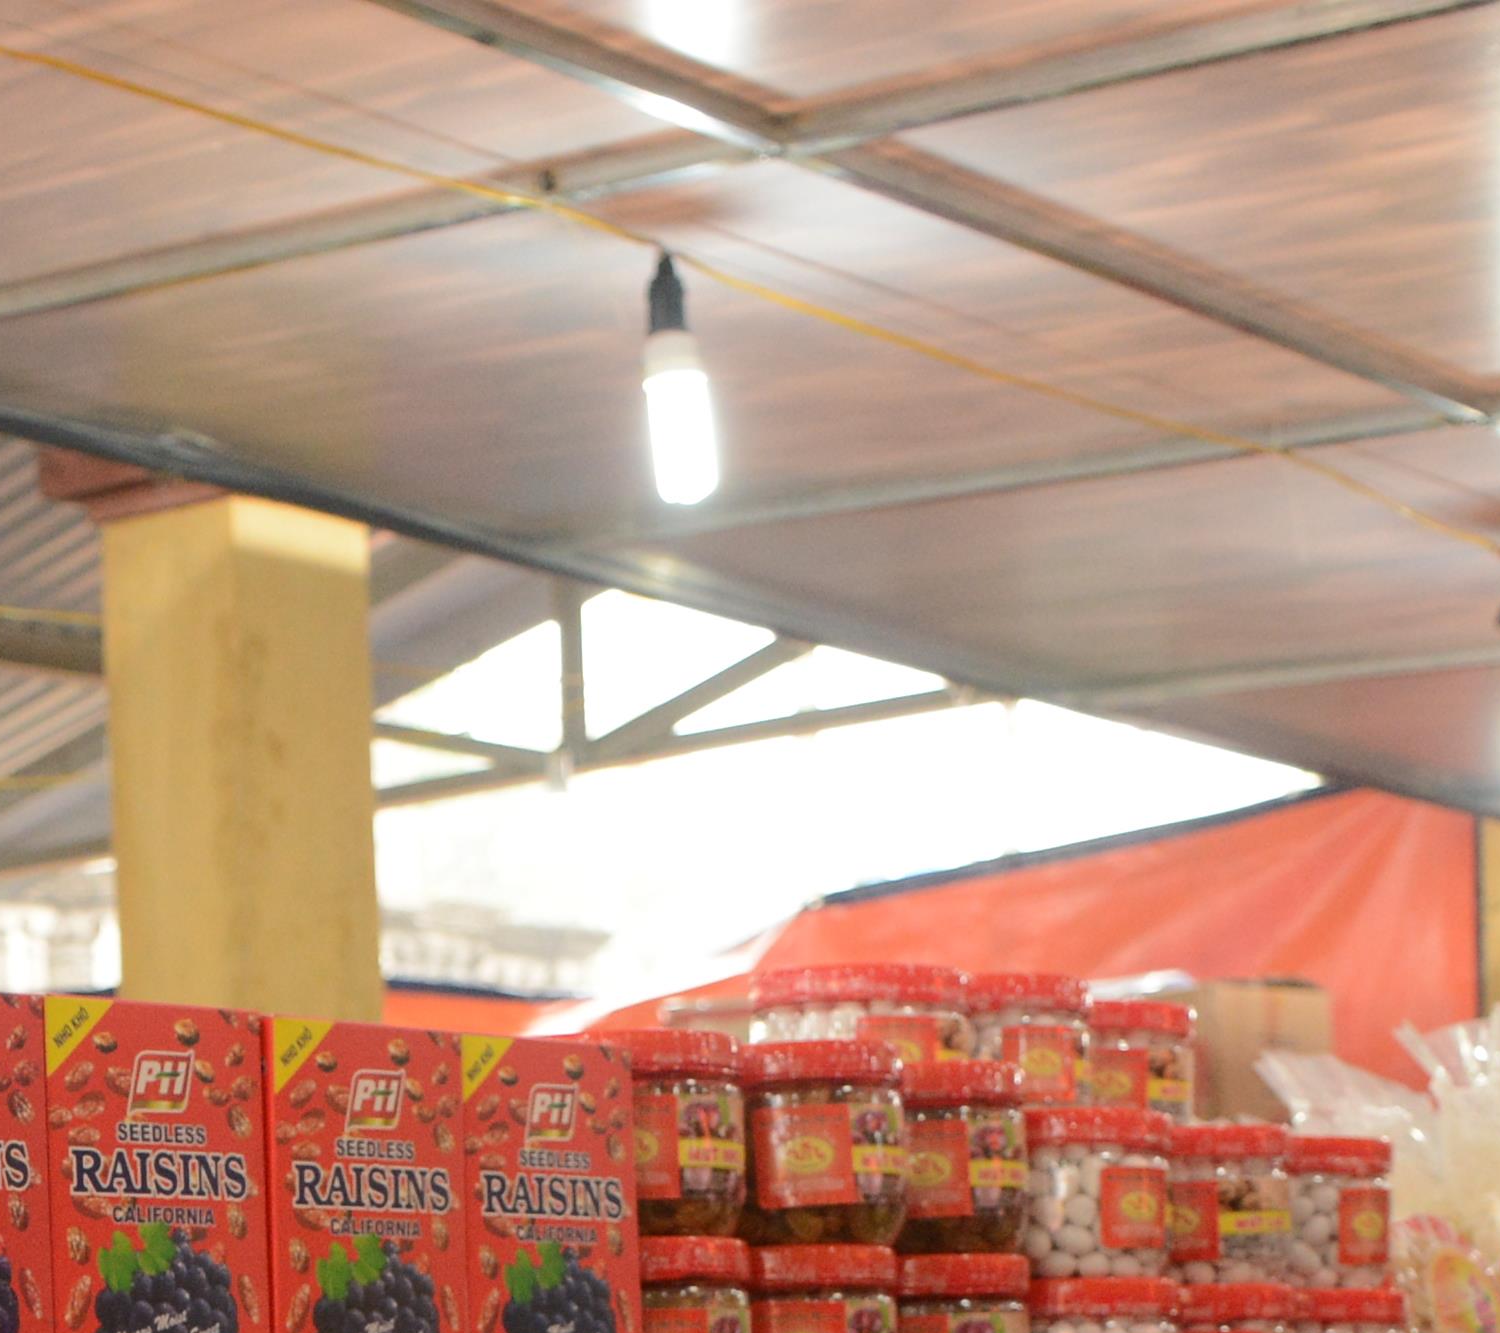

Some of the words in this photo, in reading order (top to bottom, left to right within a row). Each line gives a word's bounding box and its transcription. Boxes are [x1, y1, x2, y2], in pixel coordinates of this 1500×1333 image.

[117, 1122, 206, 1145] SEEDLESS
[70, 1148, 247, 1200] RAISINS
[291, 1160, 451, 1213] RAISINS
[481, 1169, 624, 1221] RAISINS
